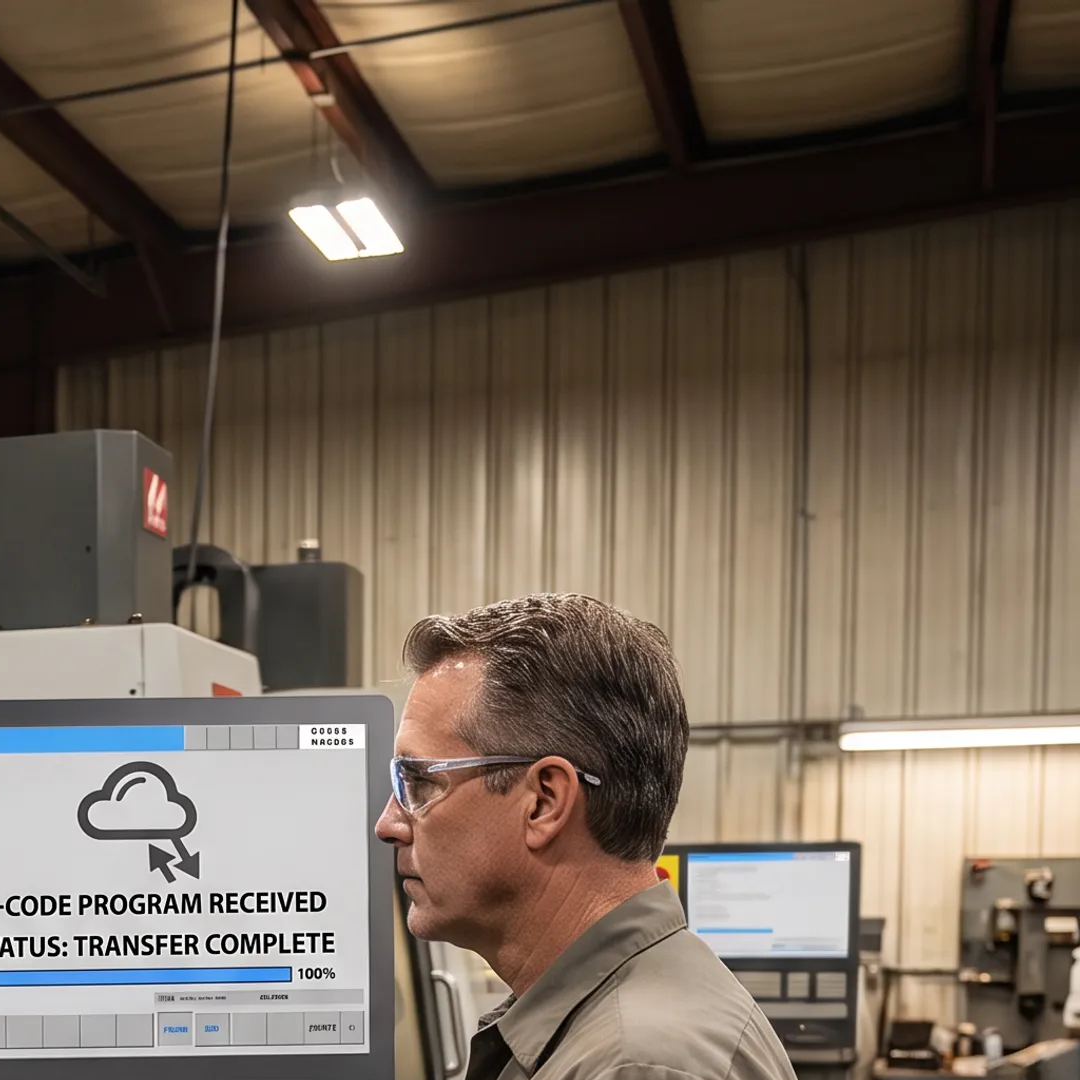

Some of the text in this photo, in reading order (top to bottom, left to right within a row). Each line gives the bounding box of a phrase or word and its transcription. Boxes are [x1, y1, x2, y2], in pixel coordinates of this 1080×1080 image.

[78, 893, 202, 915] PROGRAM
[209, 891, 327, 914] RECEIVED
[73, 934, 200, 957] TRANSFER
[205, 932, 336, 955] COMPLETE
[297, 967, 336, 980] 100%
